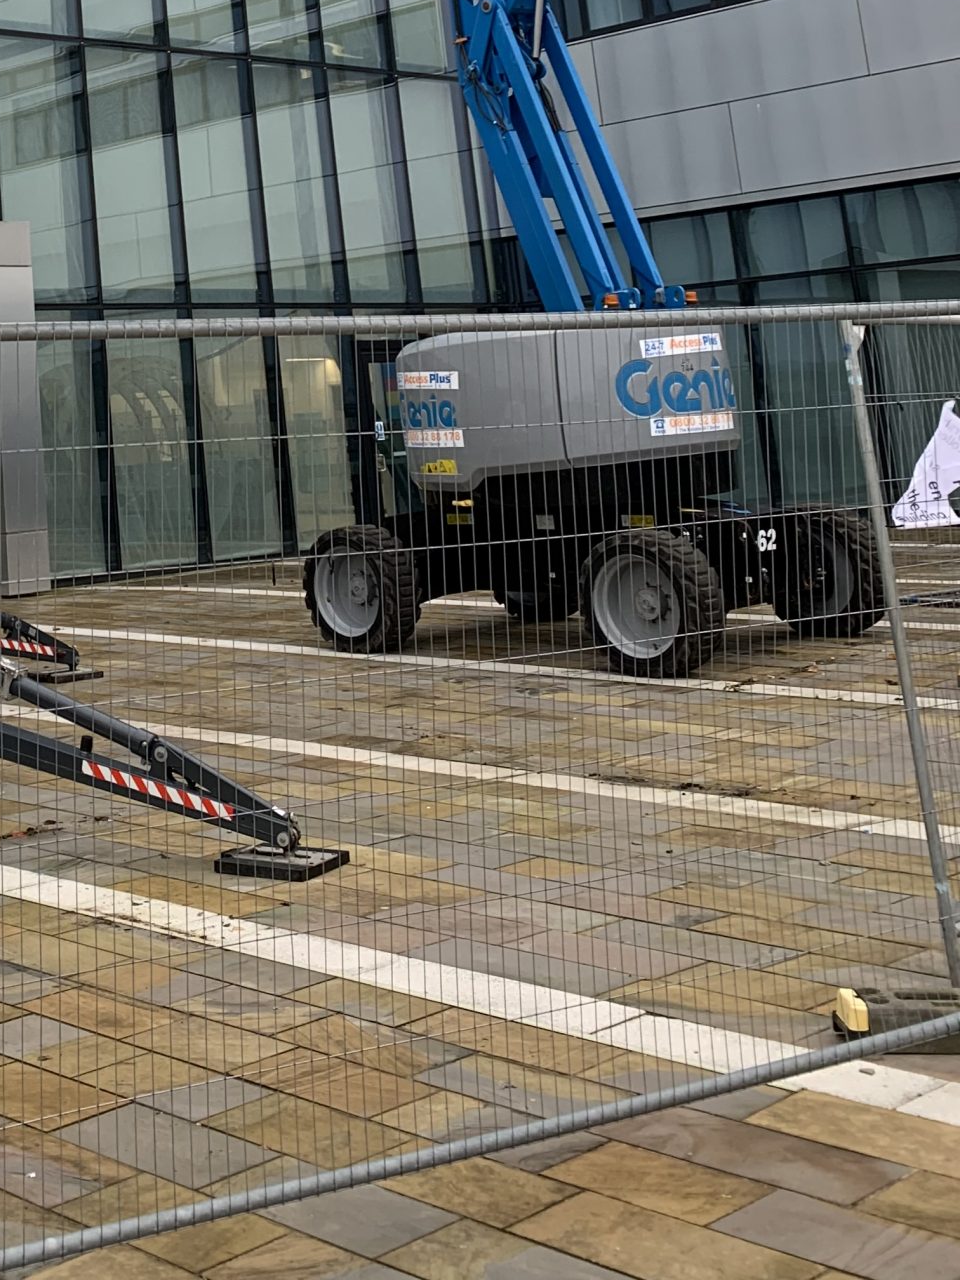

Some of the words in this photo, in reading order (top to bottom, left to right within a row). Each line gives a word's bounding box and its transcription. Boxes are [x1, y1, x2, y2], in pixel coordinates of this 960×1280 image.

[429, 373, 451, 384] Plus
[615, 355, 737, 419] Genie
[757, 528, 777, 552] 62
